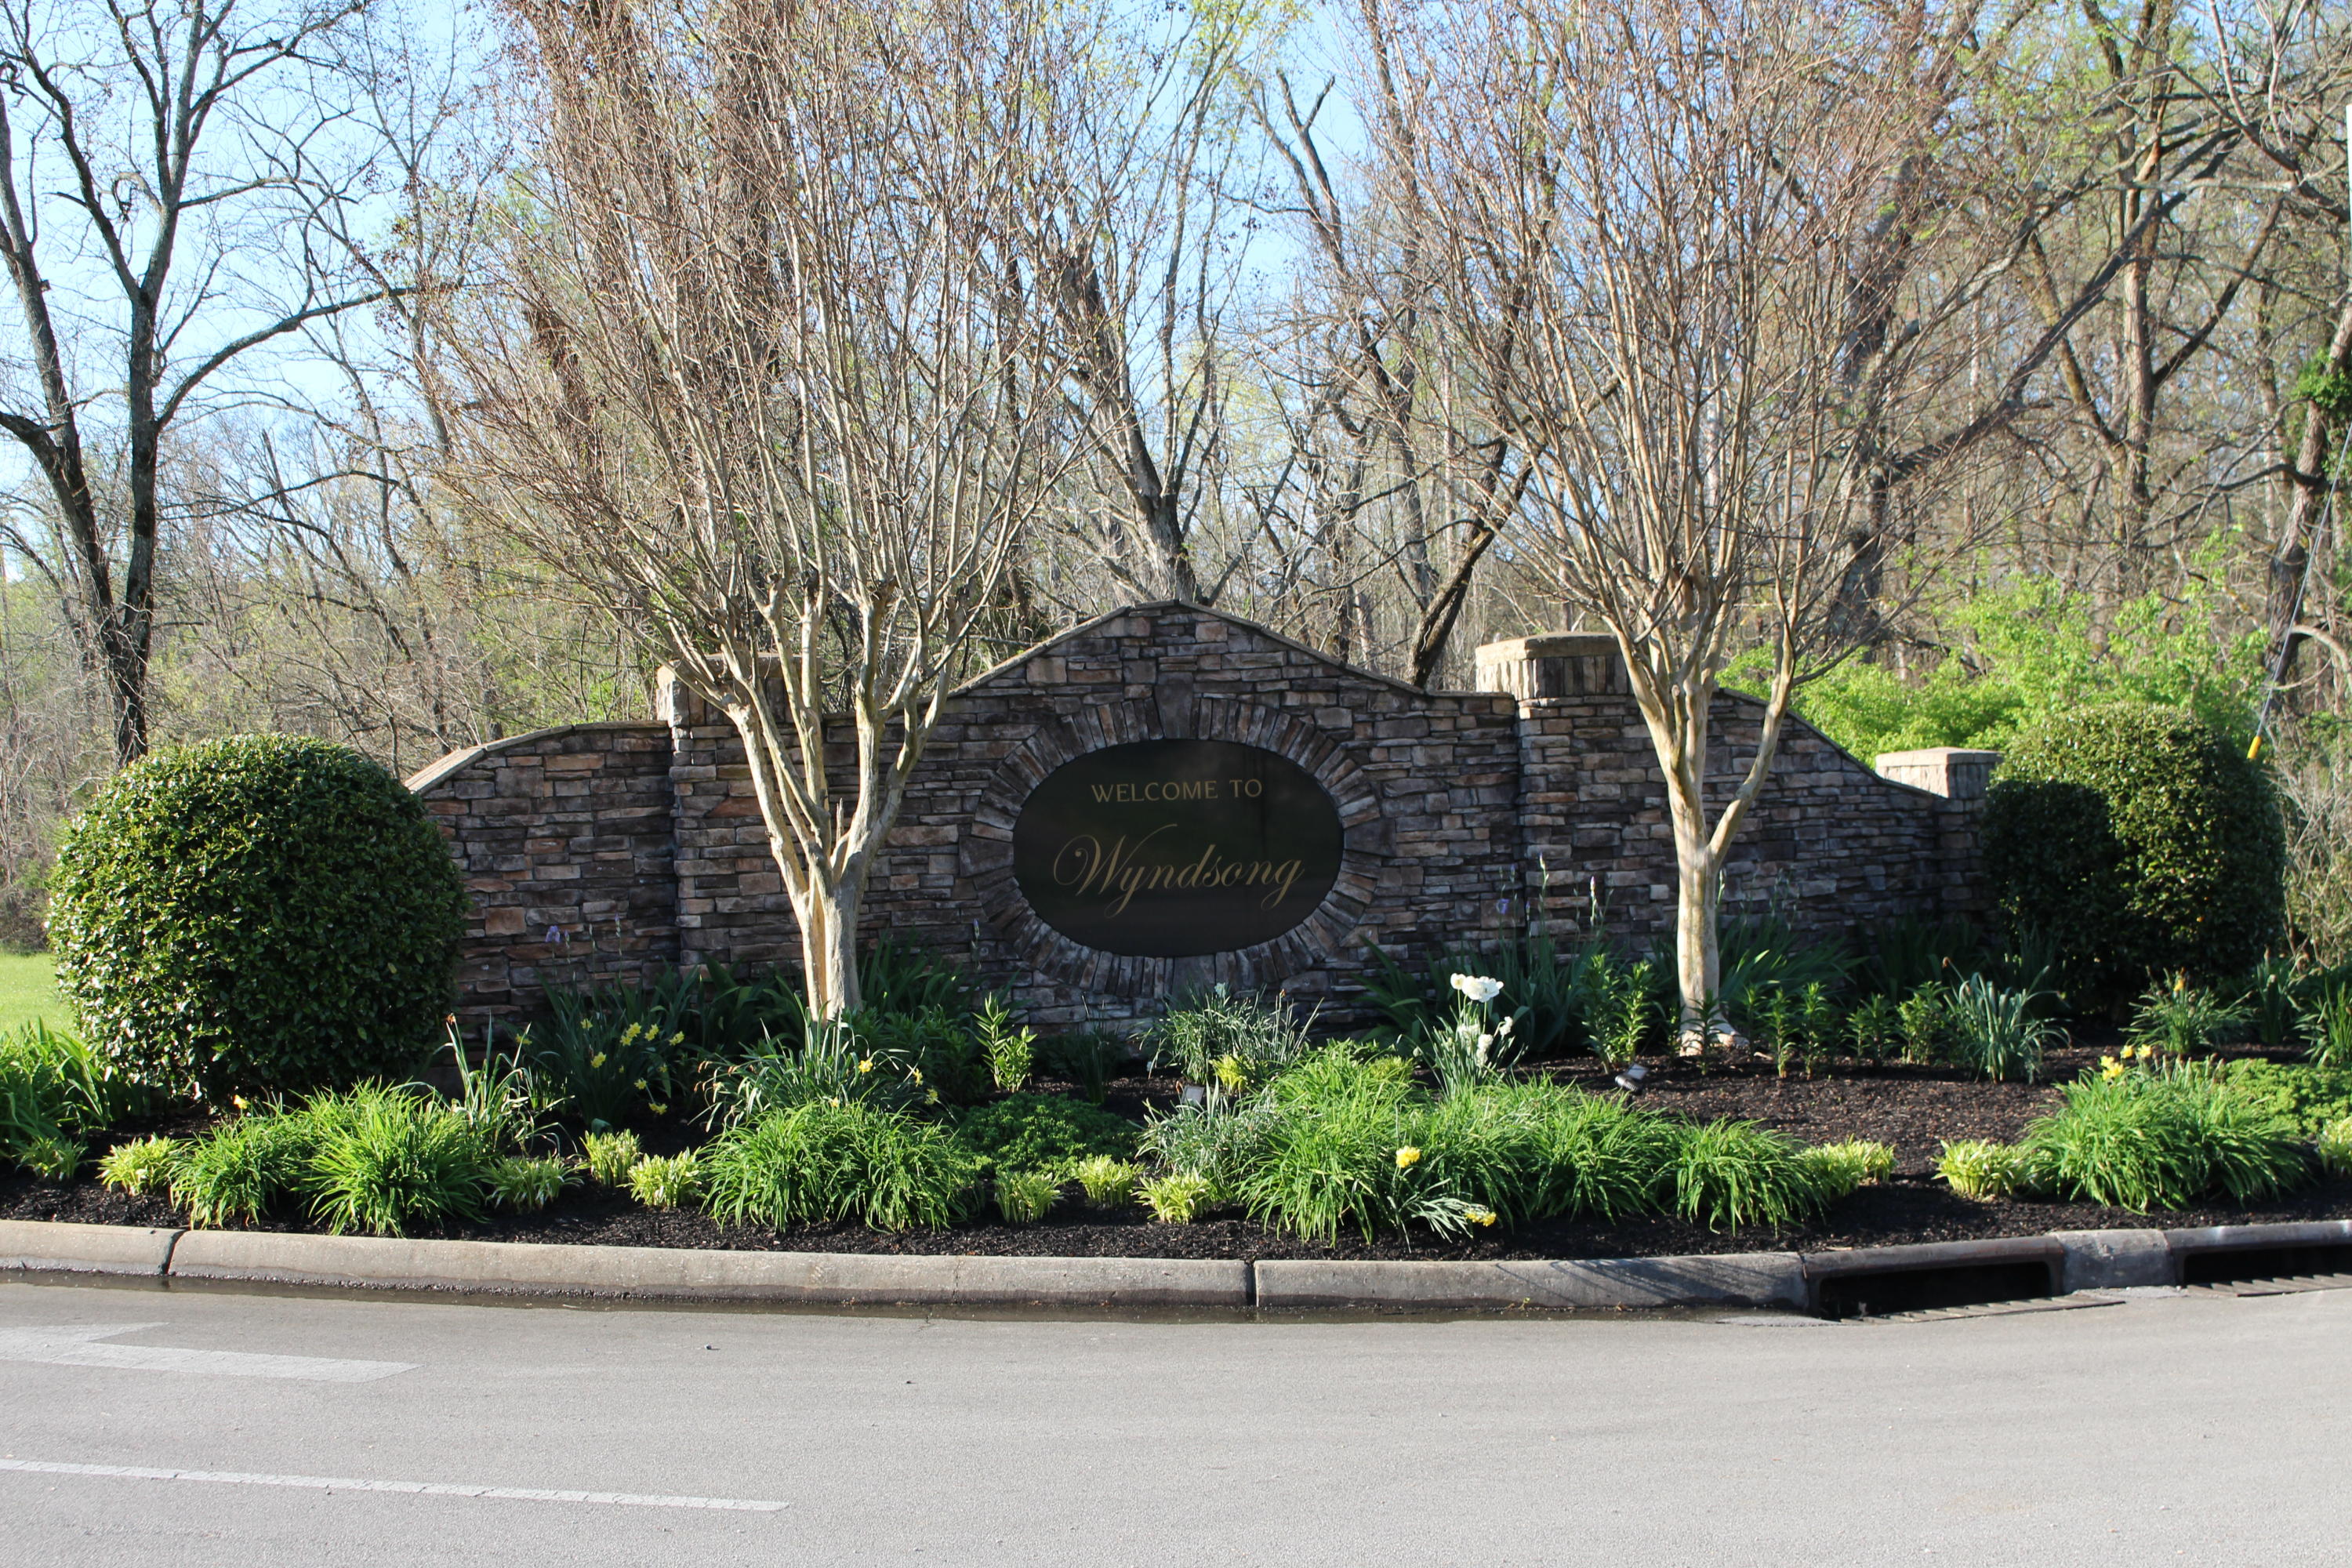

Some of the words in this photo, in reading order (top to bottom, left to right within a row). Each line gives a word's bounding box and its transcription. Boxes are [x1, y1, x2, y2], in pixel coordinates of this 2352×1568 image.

[1091, 780, 1218, 804] WELCOME
[1229, 779, 1263, 799] TO
[1053, 823, 1305, 919] Wyndsong
